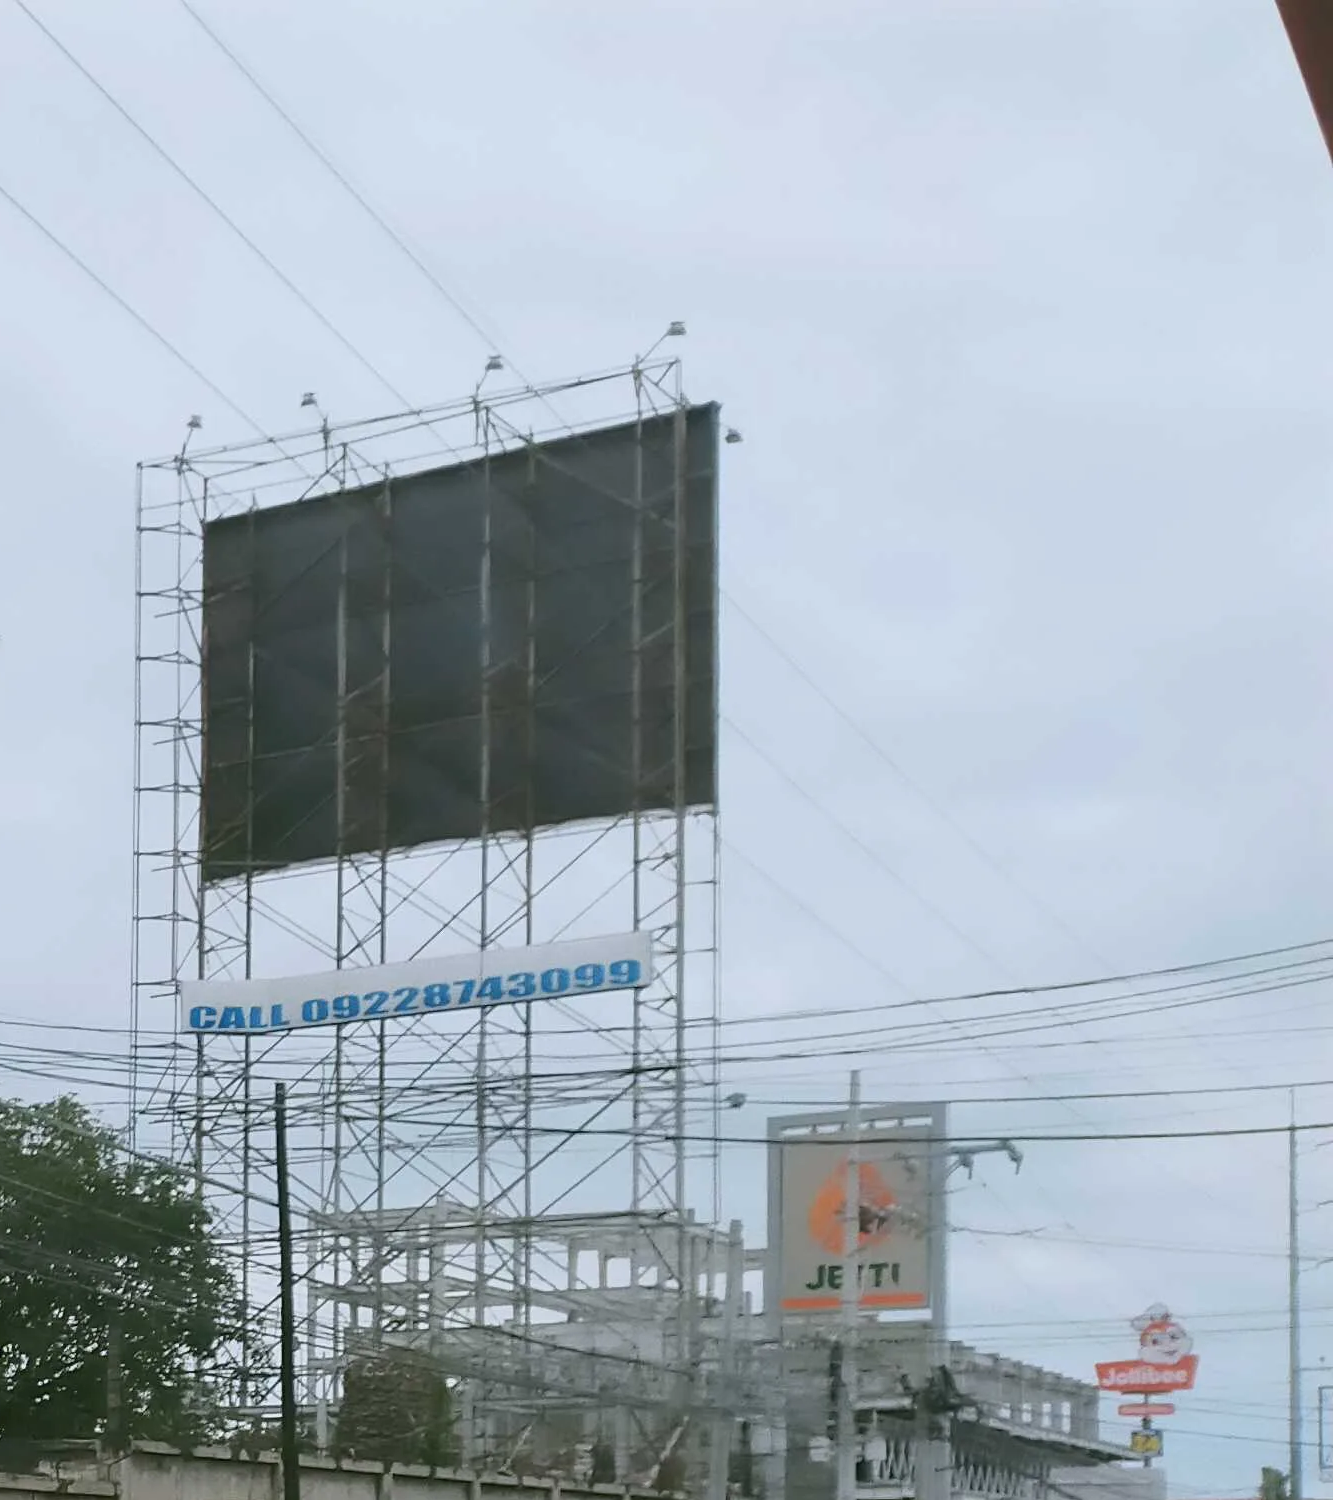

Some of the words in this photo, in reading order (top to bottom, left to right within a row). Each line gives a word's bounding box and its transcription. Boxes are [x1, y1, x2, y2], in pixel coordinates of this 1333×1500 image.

[189, 1004, 289, 1029] CALL
[300, 958, 642, 1023] 09228743099
[806, 1262, 900, 1291] JETI
